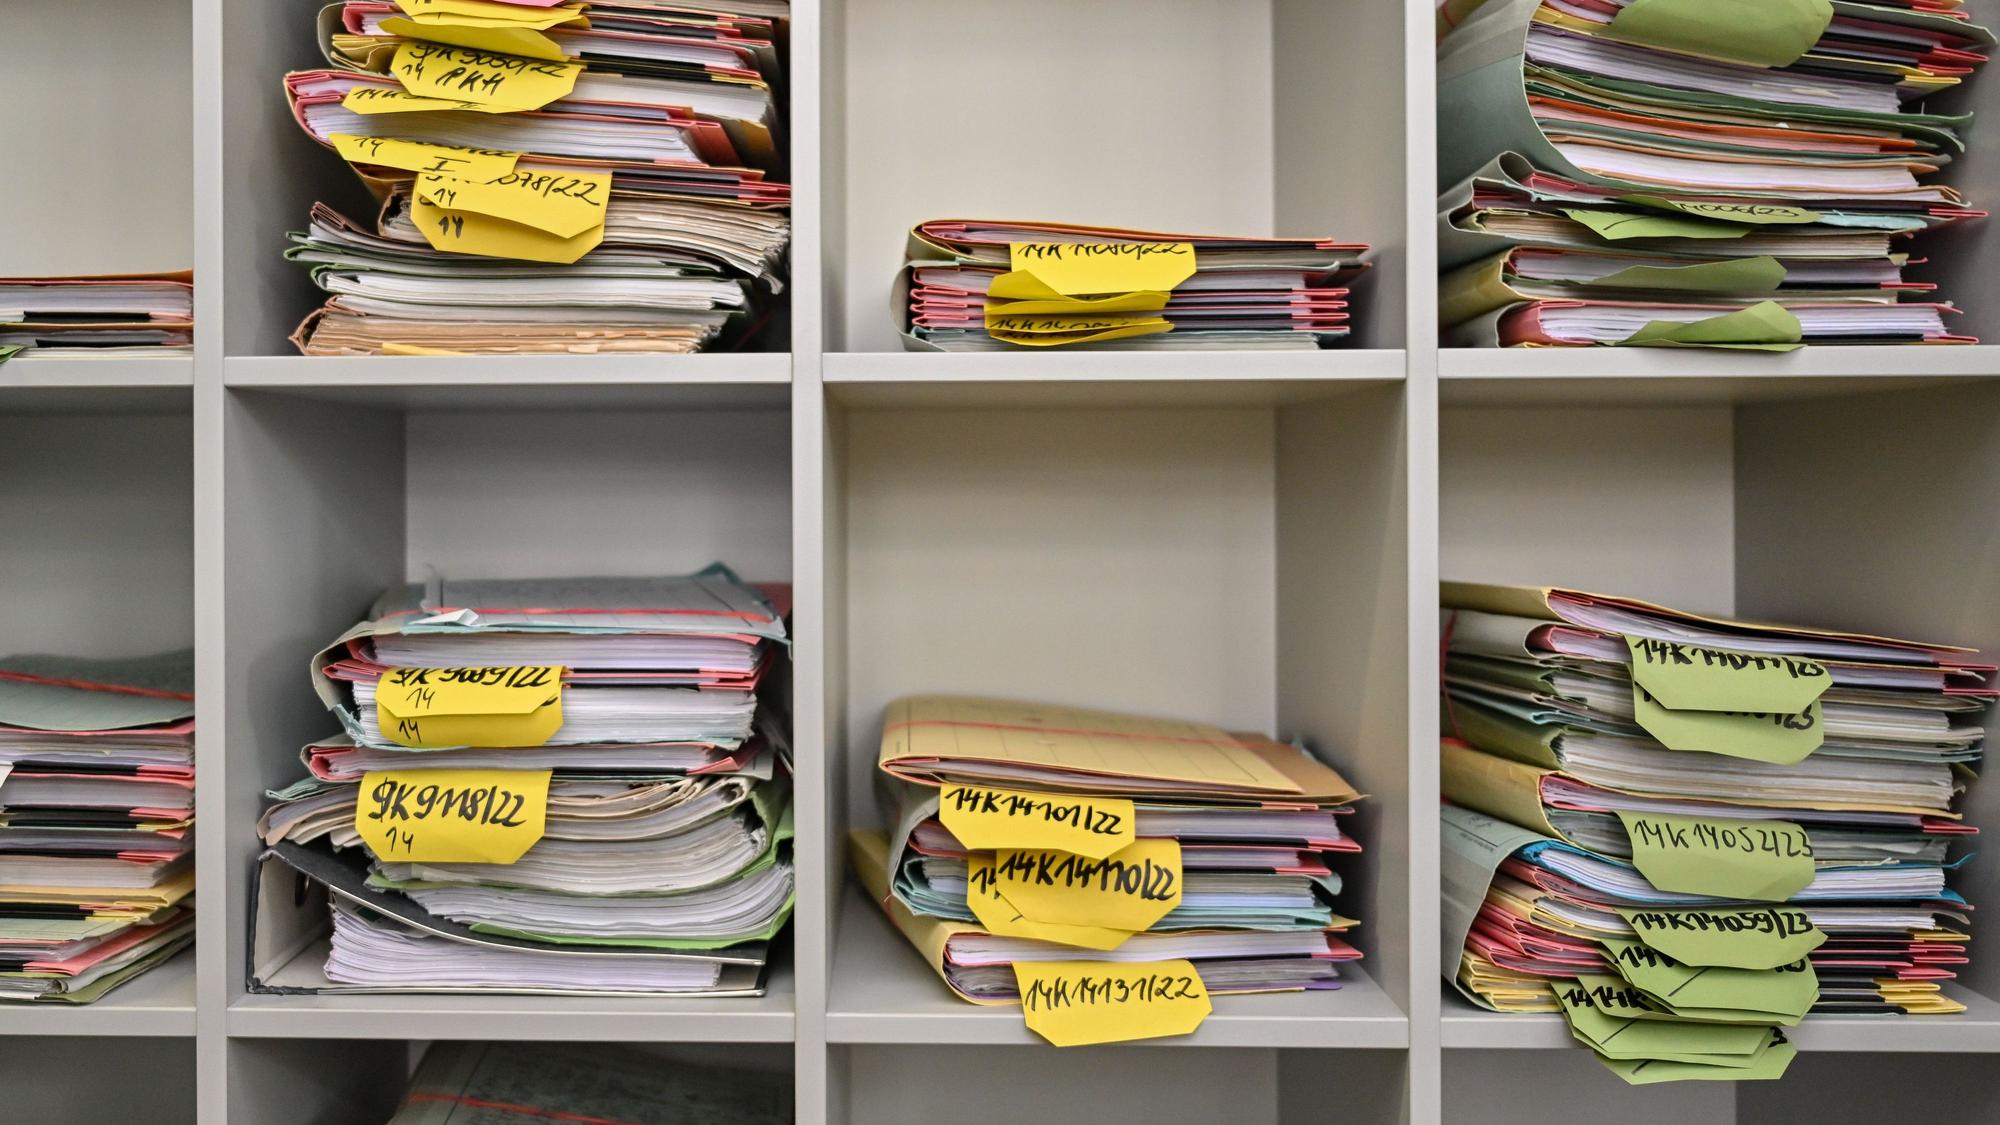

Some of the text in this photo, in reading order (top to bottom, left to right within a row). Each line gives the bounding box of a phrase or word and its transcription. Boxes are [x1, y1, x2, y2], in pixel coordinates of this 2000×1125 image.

[402, 63, 425, 81] 14
[433, 187, 457, 207] 14
[437, 215, 465, 239] 14
[406, 687, 436, 710] 14
[398, 718, 422, 744] 14
[385, 825, 415, 854] 14
